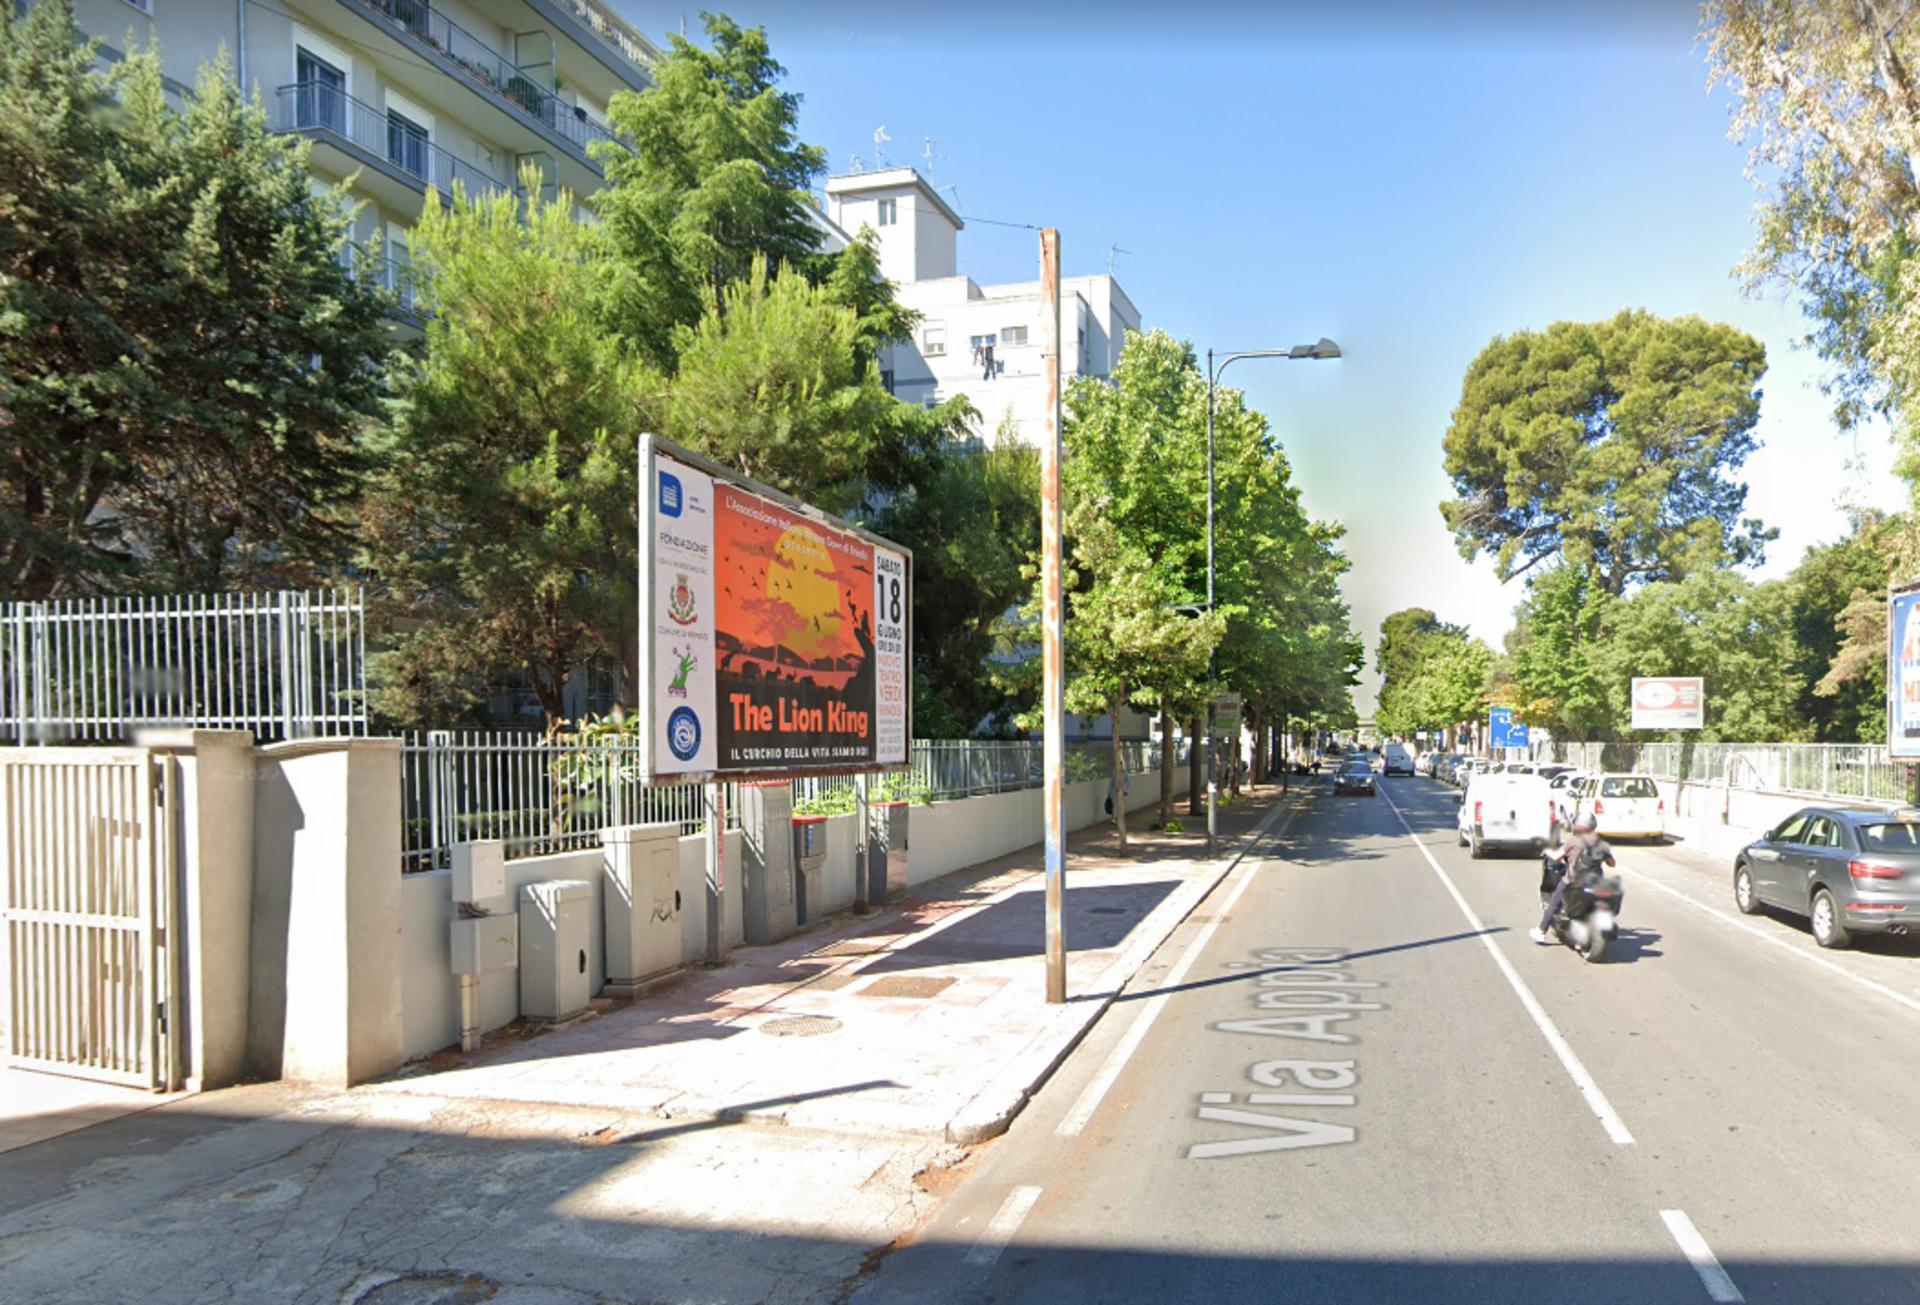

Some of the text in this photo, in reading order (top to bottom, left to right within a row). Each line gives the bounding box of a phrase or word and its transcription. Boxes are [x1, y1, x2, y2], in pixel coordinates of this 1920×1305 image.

[877, 573, 901, 624] 18
[729, 693, 868, 738] The Lion King
[731, 748, 741, 760] IL
[742, 747, 782, 760] CERCHIO
[784, 747, 810, 759] DELLA
[811, 747, 830, 758] VITA
